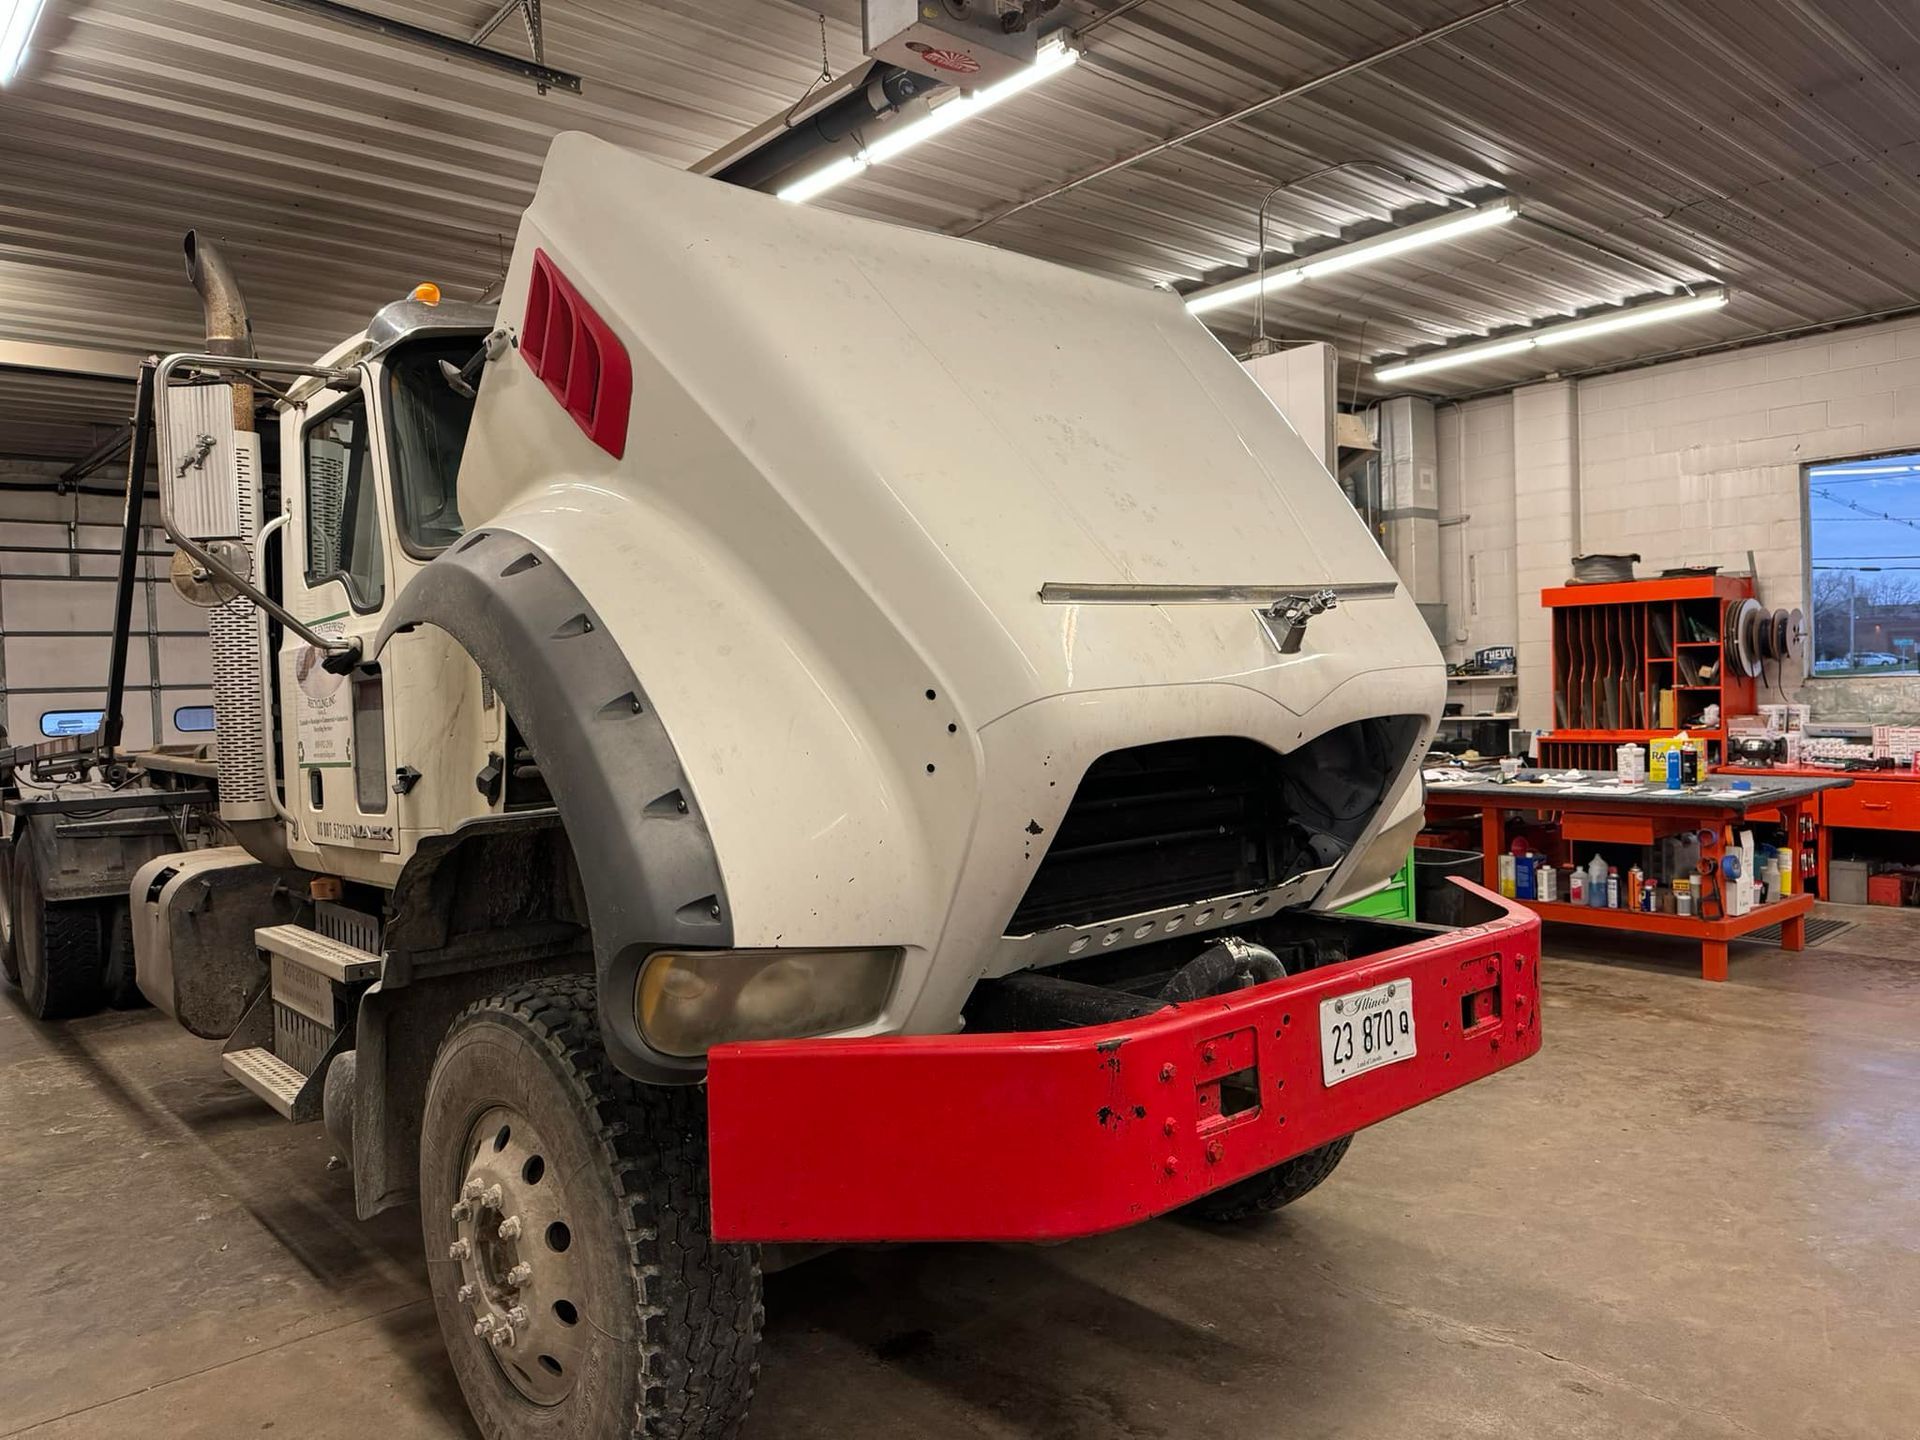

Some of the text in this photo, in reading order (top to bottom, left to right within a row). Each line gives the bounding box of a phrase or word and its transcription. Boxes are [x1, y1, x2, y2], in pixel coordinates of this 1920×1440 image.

[1484, 648, 1512, 662] CHEVY
[1652, 751, 1667, 760] RA
[352, 824, 394, 841] MACK
[1343, 994, 1391, 1016] Illinois
[1332, 1009, 1409, 1065] 23 870 Q
